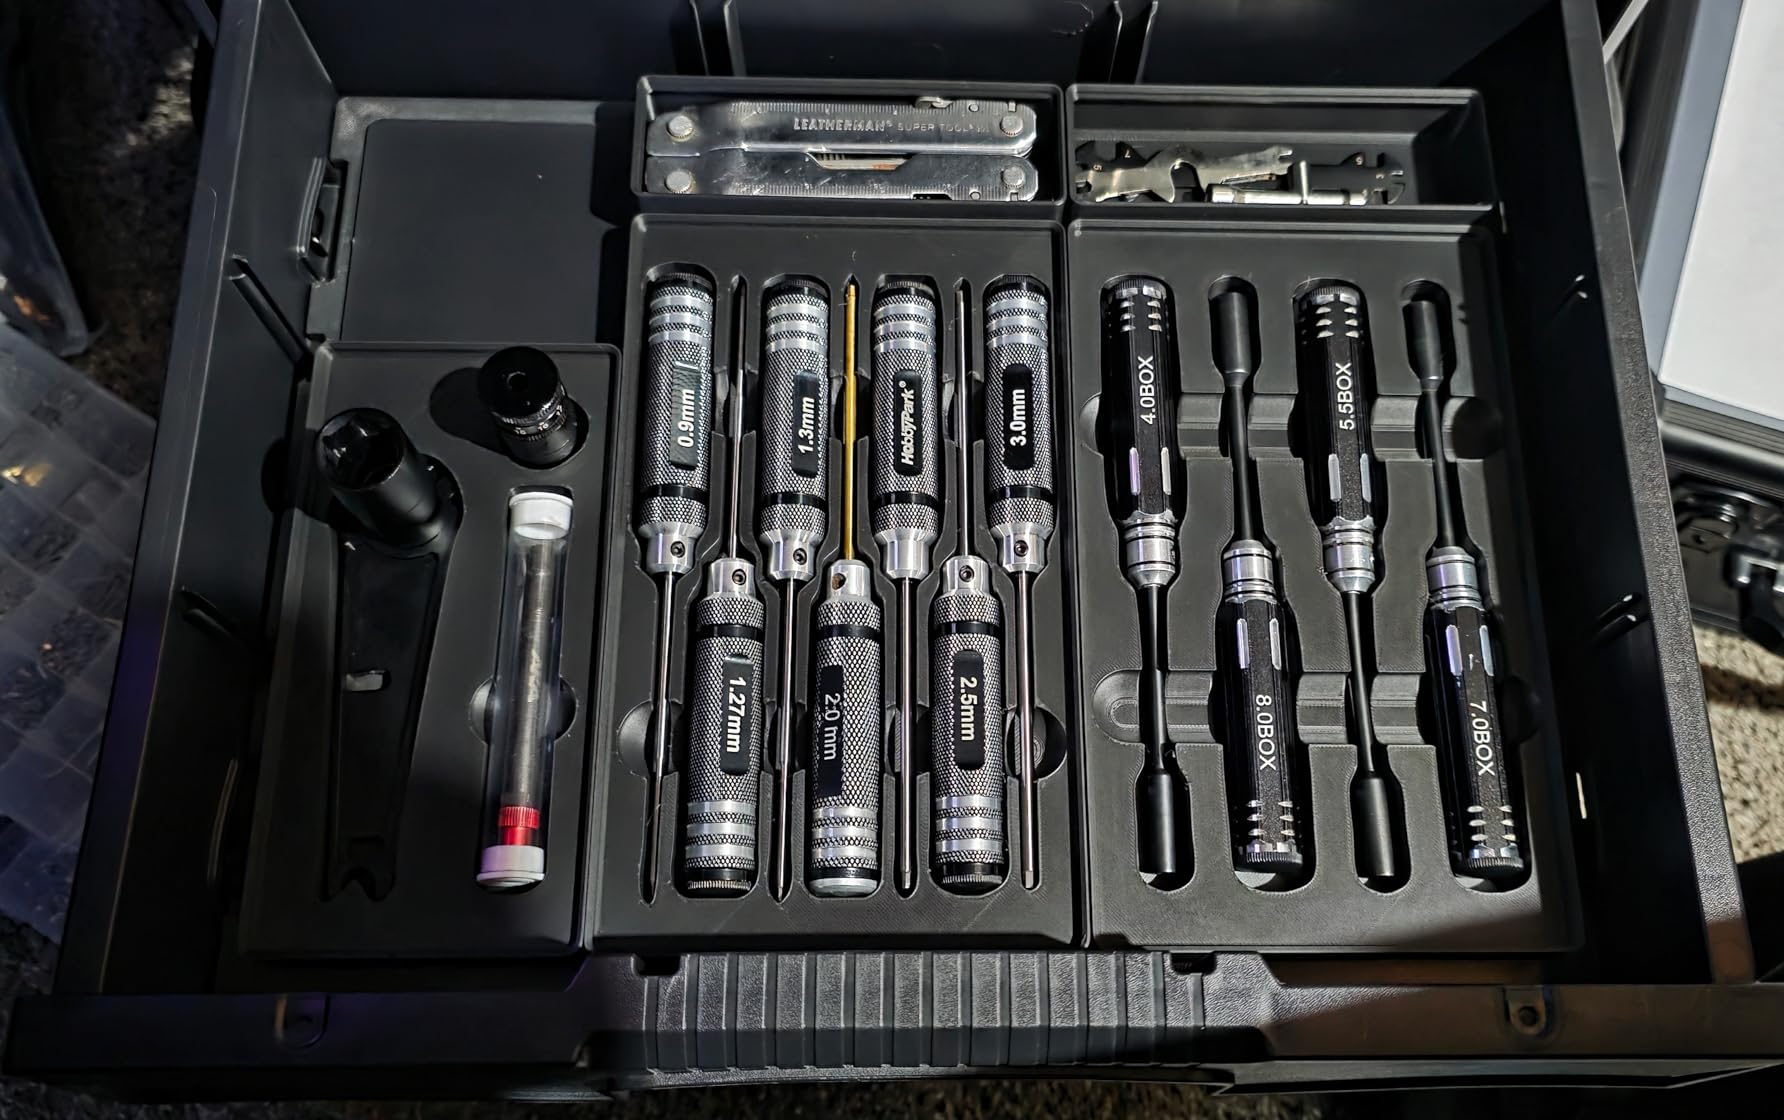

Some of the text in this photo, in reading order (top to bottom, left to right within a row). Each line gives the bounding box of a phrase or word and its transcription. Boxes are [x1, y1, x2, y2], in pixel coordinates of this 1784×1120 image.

[897, 123, 935, 133] SUPER
[677, 389, 696, 448] 0.9mm
[1009, 388, 1027, 446] 3.0mm
[1137, 355, 1156, 425] 4.0BOX
[1335, 362, 1354, 431] 5.5BOX
[798, 396, 816, 453] 1.3mm
[726, 677, 747, 754] 1.27mm
[959, 676, 977, 742] 2.5mm
[1255, 694, 1278, 772] 8.0BOX
[1469, 700, 1495, 777] 7.0BOX
